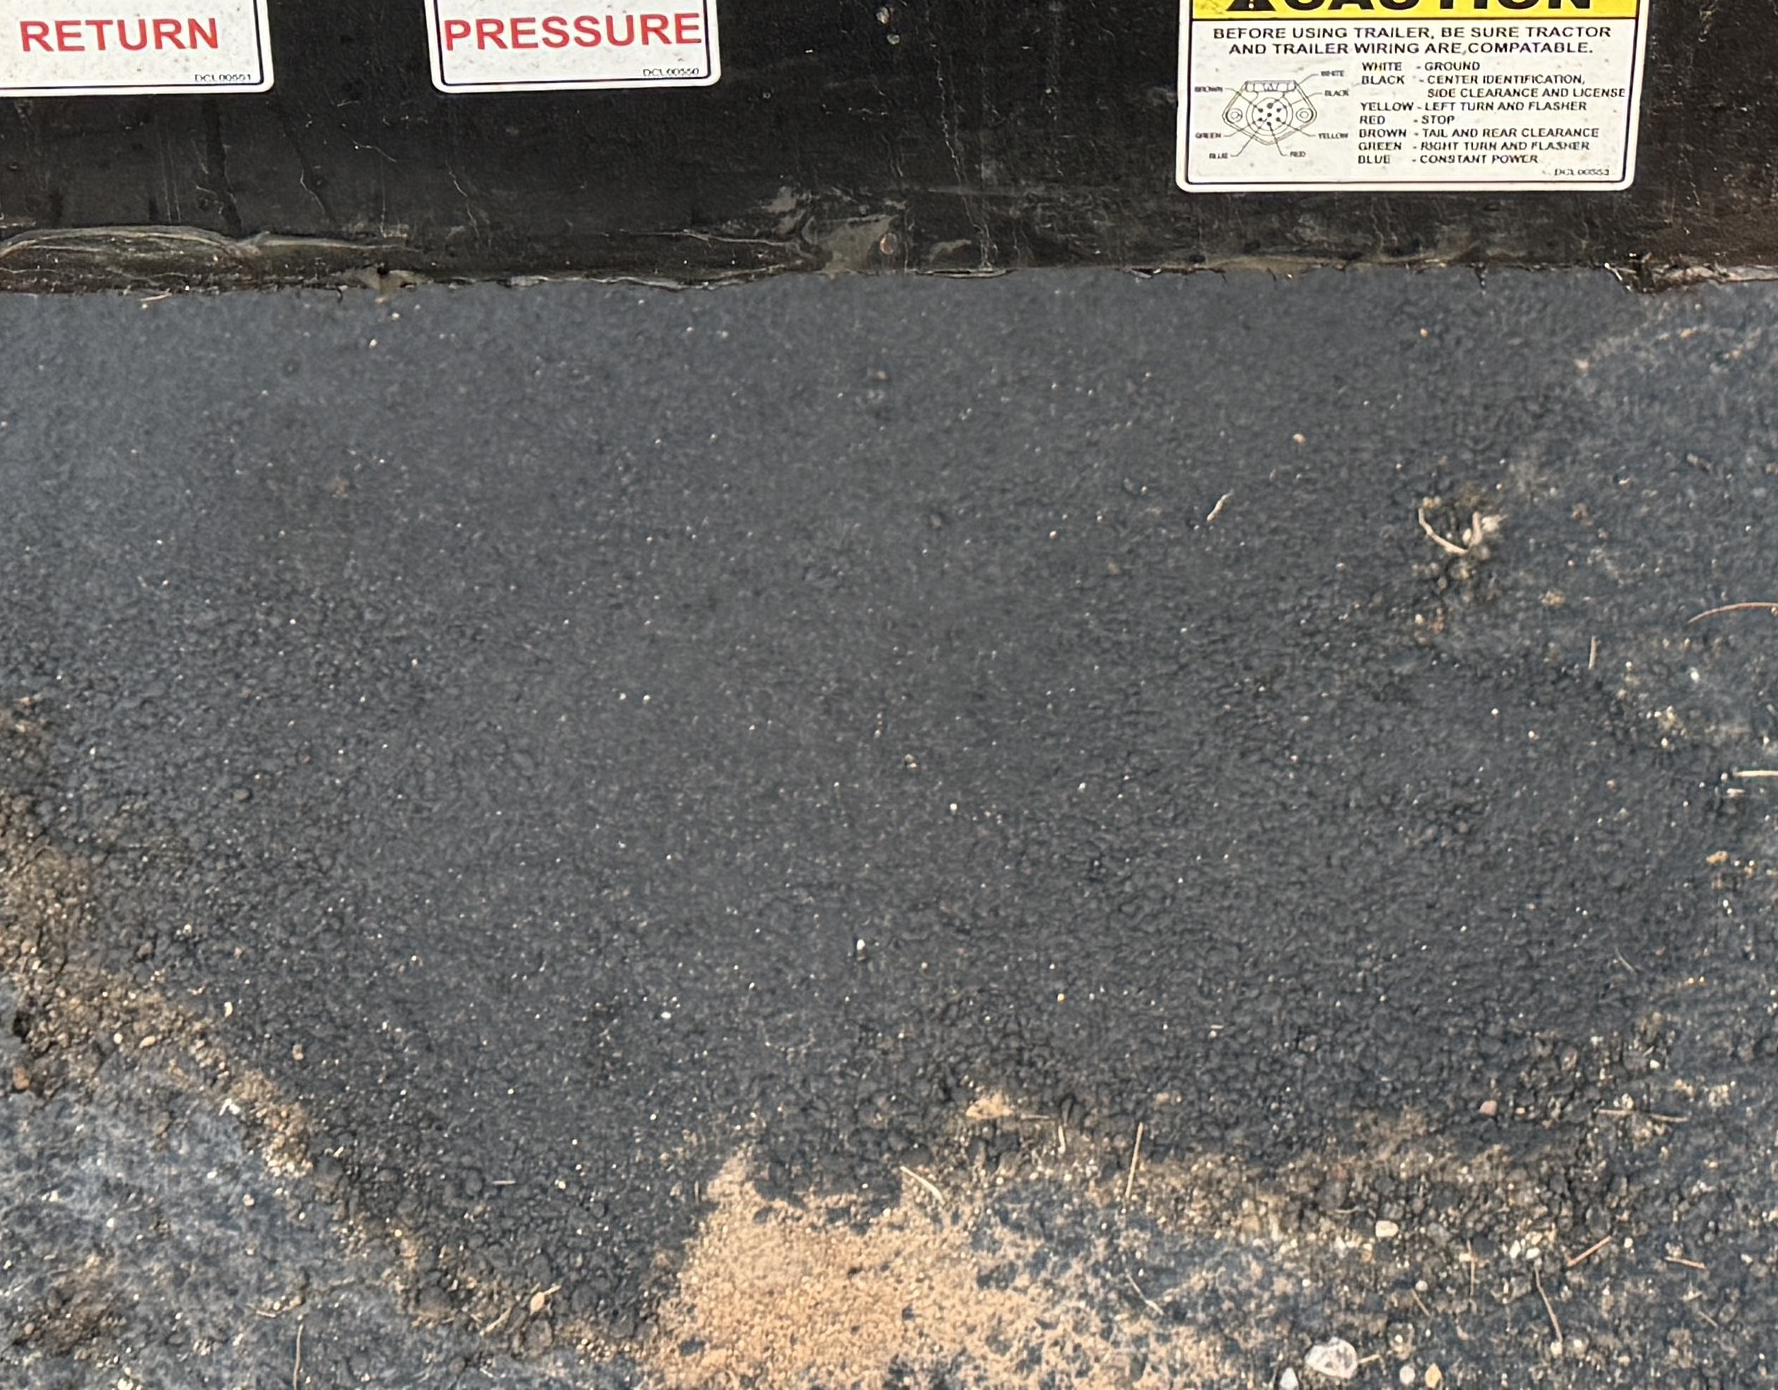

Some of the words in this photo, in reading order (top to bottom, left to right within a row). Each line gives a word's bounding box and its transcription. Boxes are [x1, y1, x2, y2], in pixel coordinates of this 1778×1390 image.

[21, 16, 219, 52] RETURN
[444, 11, 701, 50] PRESSURE
[1213, 27, 1286, 39] BEFORE
[1292, 27, 1348, 39] USING
[1354, 27, 1435, 40] TRAILER,
[1441, 27, 1465, 38] BE
[1471, 27, 1520, 38] SURE
[1526, 26, 1611, 38] TRACTOR
[1229, 43, 1267, 54] AND
[1273, 43, 1349, 54] TRAILER
[1354, 42, 1420, 54] WIRING
[1468, 42, 1594, 54] COMPATABLE.
[1361, 62, 1403, 71] WHITE
[1424, 61, 1480, 71] GROUND
[1361, 75, 1405, 85] BLACK
[1427, 75, 1479, 85] CENTER
[1482, 74, 1585, 85] IDENTIFICATION,
[1427, 88, 1456, 98] SIDE
[1460, 88, 1539, 98] CLEARANCE
[1541, 88, 1569, 97] AND
[1573, 88, 1626, 97] LICENSE
[1360, 102, 1414, 111] YELLOW
[1424, 102, 1456, 111] LEFT
[1460, 101, 1494, 111] TURN
[1497, 101, 1525, 111] AND
[1528, 101, 1587, 111] FLASHER
[1359, 115, 1386, 125] RED
[1421, 115, 1455, 125] STOP
[1359, 128, 1407, 138] BROWN
[1422, 128, 1448, 138] TAIL
[1452, 128, 1478, 138] AND
[1482, 128, 1518, 138] REAR
[1521, 128, 1600, 138] CLEARANCE
[1358, 141, 1402, 151] GREEN
[1420, 141, 1459, 151] RIGHT
[1464, 141, 1497, 151] TURN
[1501, 141, 1527, 150] AND
[1531, 141, 1590, 150] FLASHER
[1357, 154, 1390, 164] BLUE
[1420, 154, 1487, 164] CONSTANT
[1491, 154, 1539, 164] POWER
